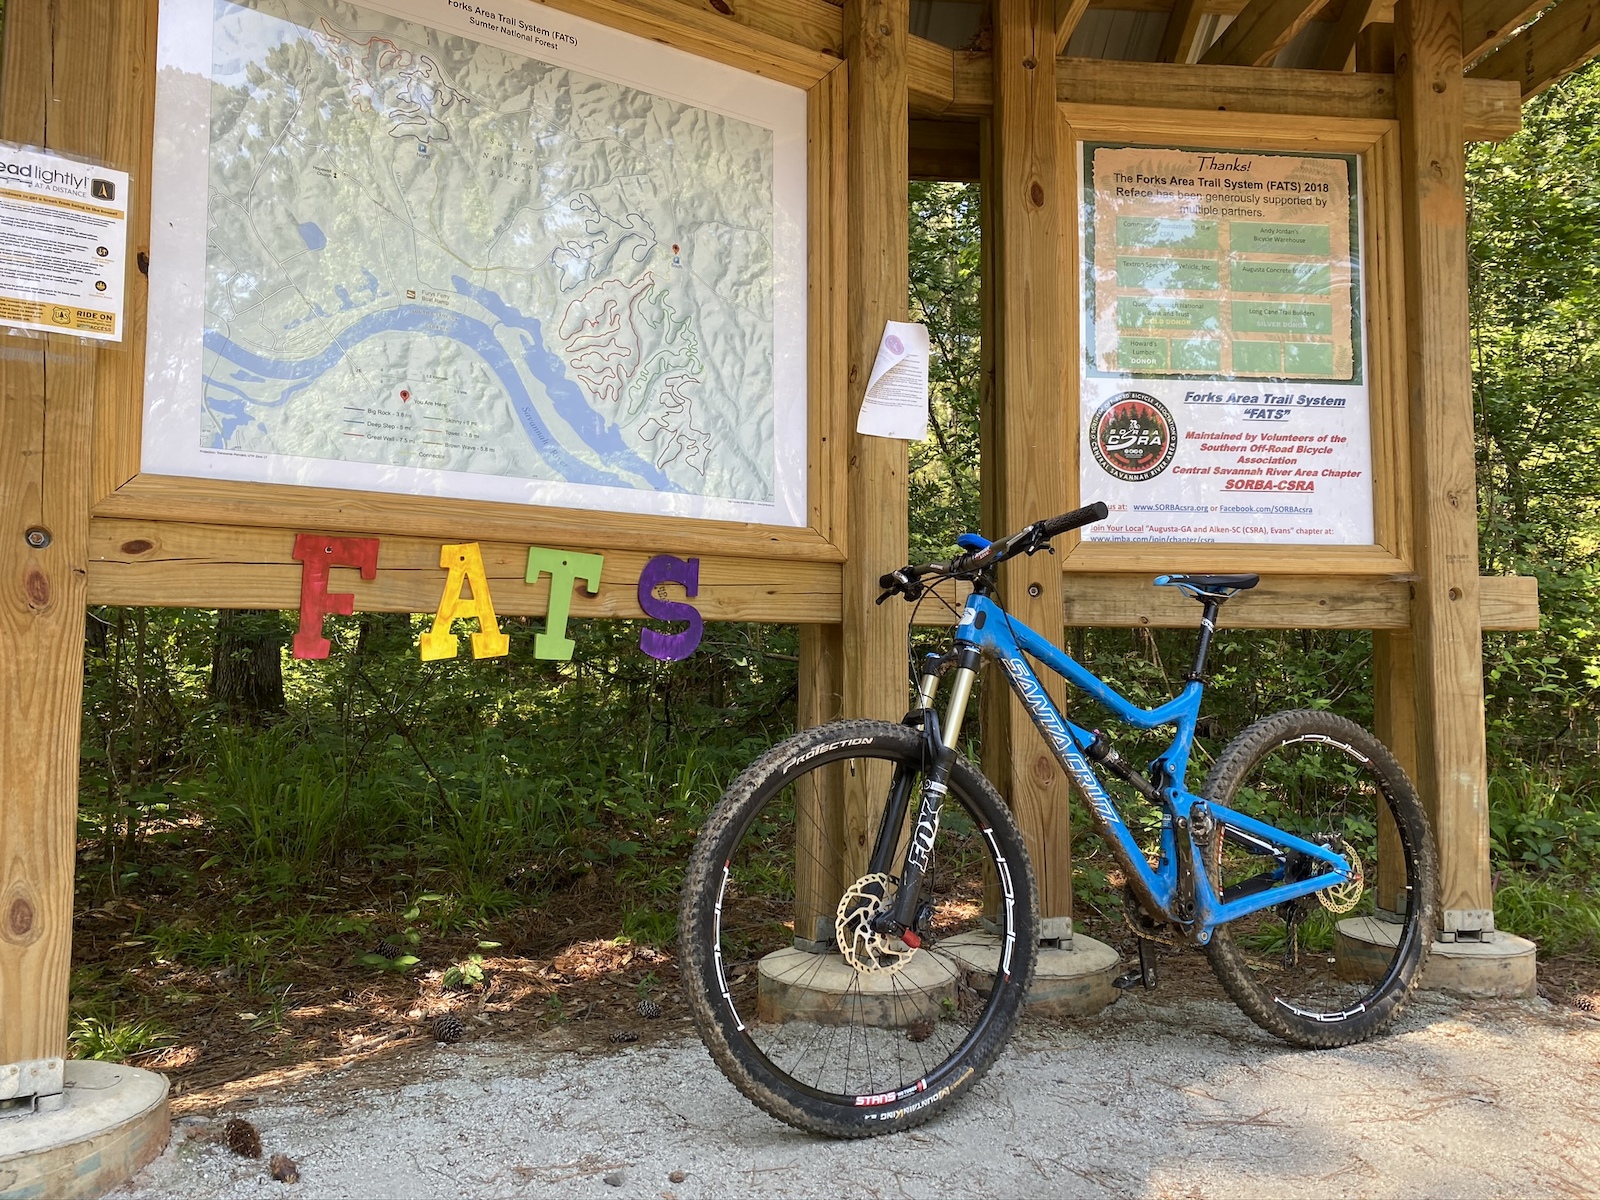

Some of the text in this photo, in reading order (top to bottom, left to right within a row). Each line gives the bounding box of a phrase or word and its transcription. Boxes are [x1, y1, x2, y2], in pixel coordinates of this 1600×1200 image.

[448, 0, 578, 46] Forks Area Trail System (FATS)
[470, 17, 558, 50] Sumter National Forest
[490, 138, 534, 154] Sumter
[482, 152, 540, 172] National
[1198, 156, 1252, 172] Thanks!
[34, 166, 87, 190] lightly!
[490, 170, 533, 186] Forest
[1114, 172, 1328, 192] The Forks Area Trail System (FATS) 2018
[53, 186, 87, 198] DISTANCE
[1116, 187, 1328, 208] Reface has been generously supported by
[1180, 204, 1265, 217] multiple partners.
[76, 310, 98, 319] RIDE
[100, 312, 112, 321] ON
[1184, 392, 1346, 406] Forks Area Trail System
[1132, 393, 1154, 403] BICYCLE
[1154, 402, 1176, 436] ASSOCIATION
[521, 406, 569, 470] Savannah River
[1106, 434, 1162, 448] CSRA
[1185, 431, 1347, 442] Maintained by Volunteers of the
[1200, 443, 1334, 456] Southern Off-Road Bicycle
[1092, 442, 1176, 480] CENTRAL SAVANNAH RIVER AREA
[1236, 455, 1298, 465] Association
[1172, 466, 1362, 478] Central Savannah River Area Chapter
[1224, 479, 1314, 491] SORBA-CSRA
[1133, 504, 1208, 512] www.SORBAcsra.org
[1220, 504, 1313, 514] Facebook.com/SORBAcsra
[1242, 526, 1268, 535] (CSRA),
[1296, 528, 1324, 536] chapter
[293, 534, 704, 662] FATS
[1002, 658, 1072, 751] SANTA
[783, 738, 874, 774] PROTECTION
[1062, 753, 1120, 823] CRUZ
[908, 796, 944, 873] FOX
